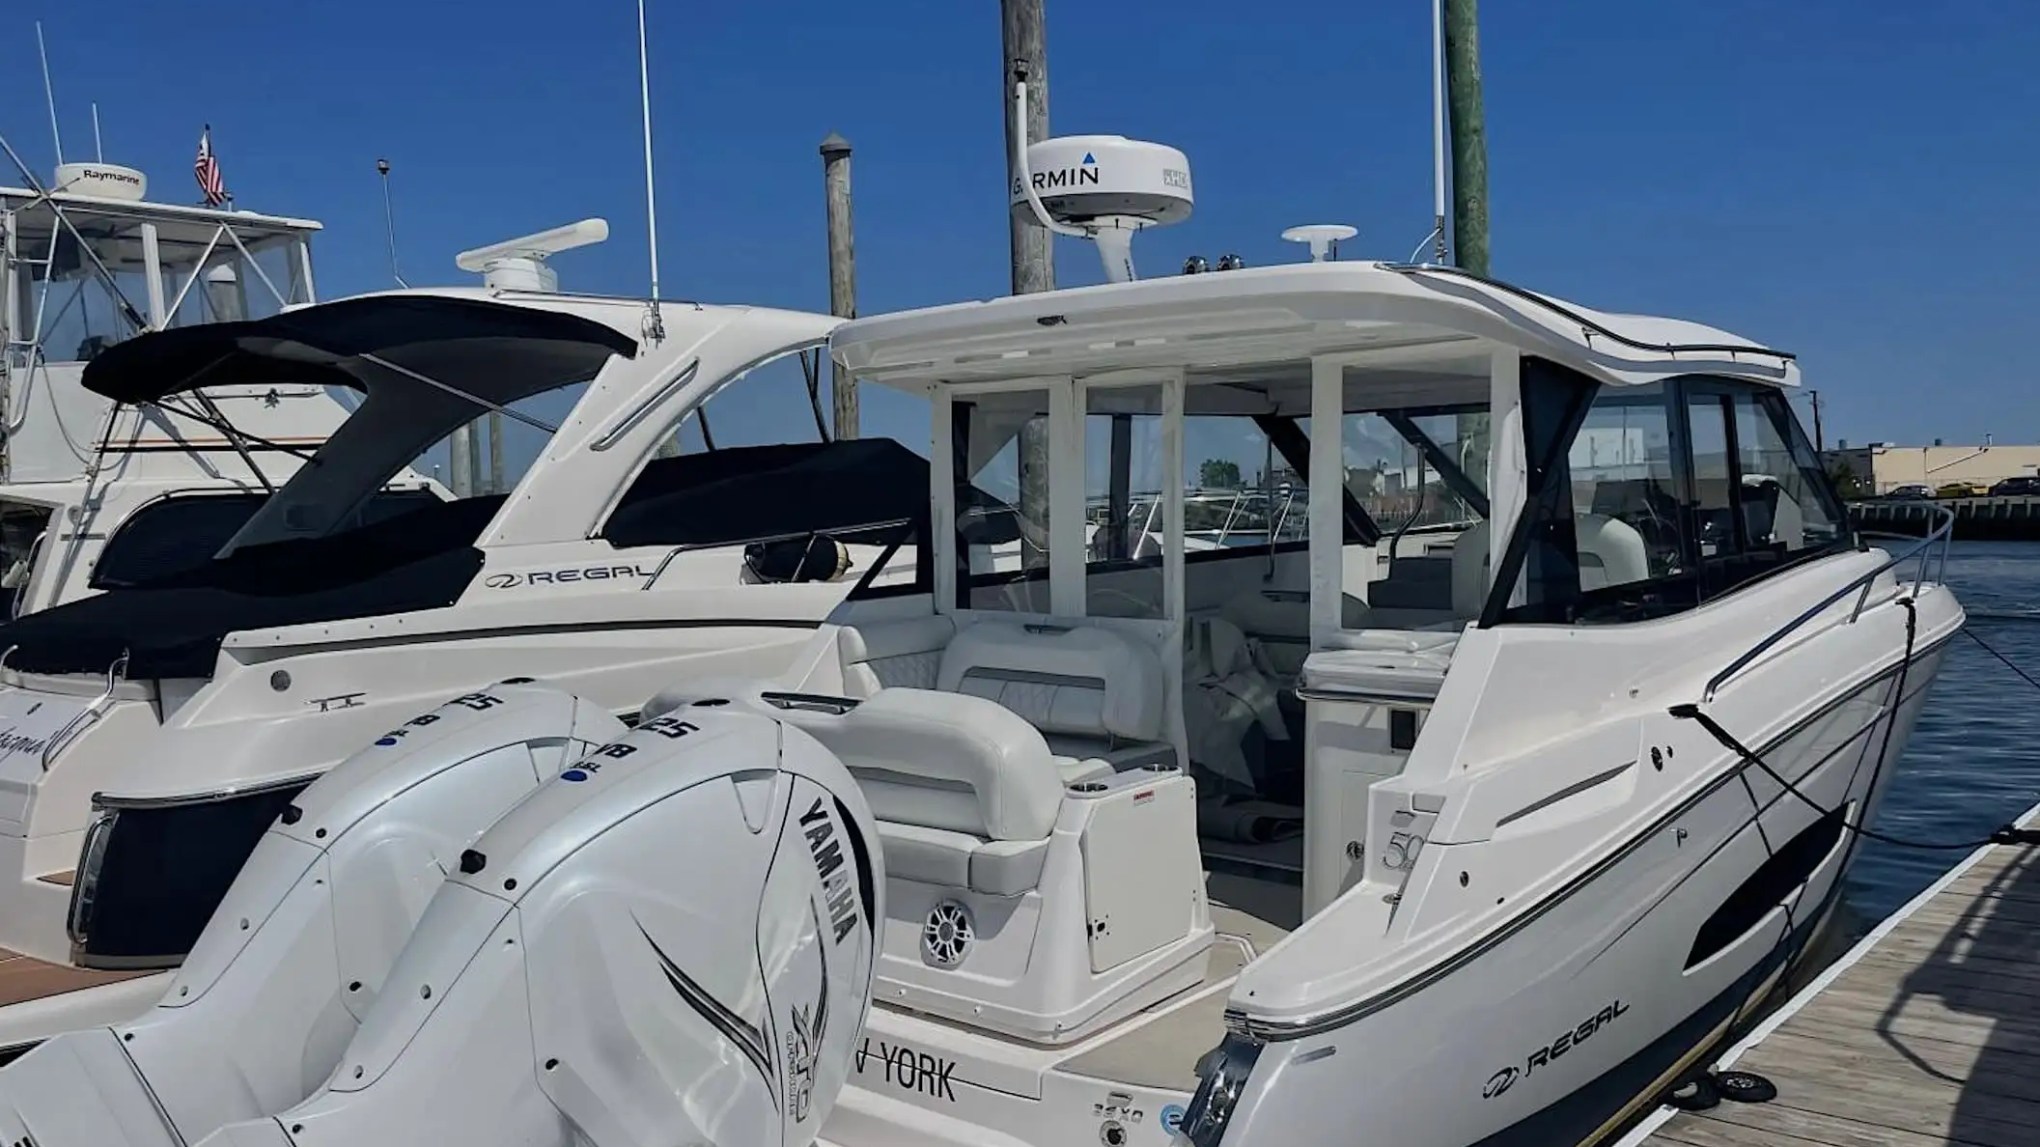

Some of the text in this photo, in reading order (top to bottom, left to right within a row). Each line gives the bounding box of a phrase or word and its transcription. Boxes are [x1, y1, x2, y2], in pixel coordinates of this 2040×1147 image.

[83, 169, 140, 185] Raymarine
[1012, 166, 1100, 195] GRMIN
[527, 565, 655, 585] REGAL
[638, 717, 700, 738] 25
[799, 796, 858, 946] YAMAHA
[1525, 999, 1630, 1077] REGAL
[880, 1041, 956, 1102] YORK
